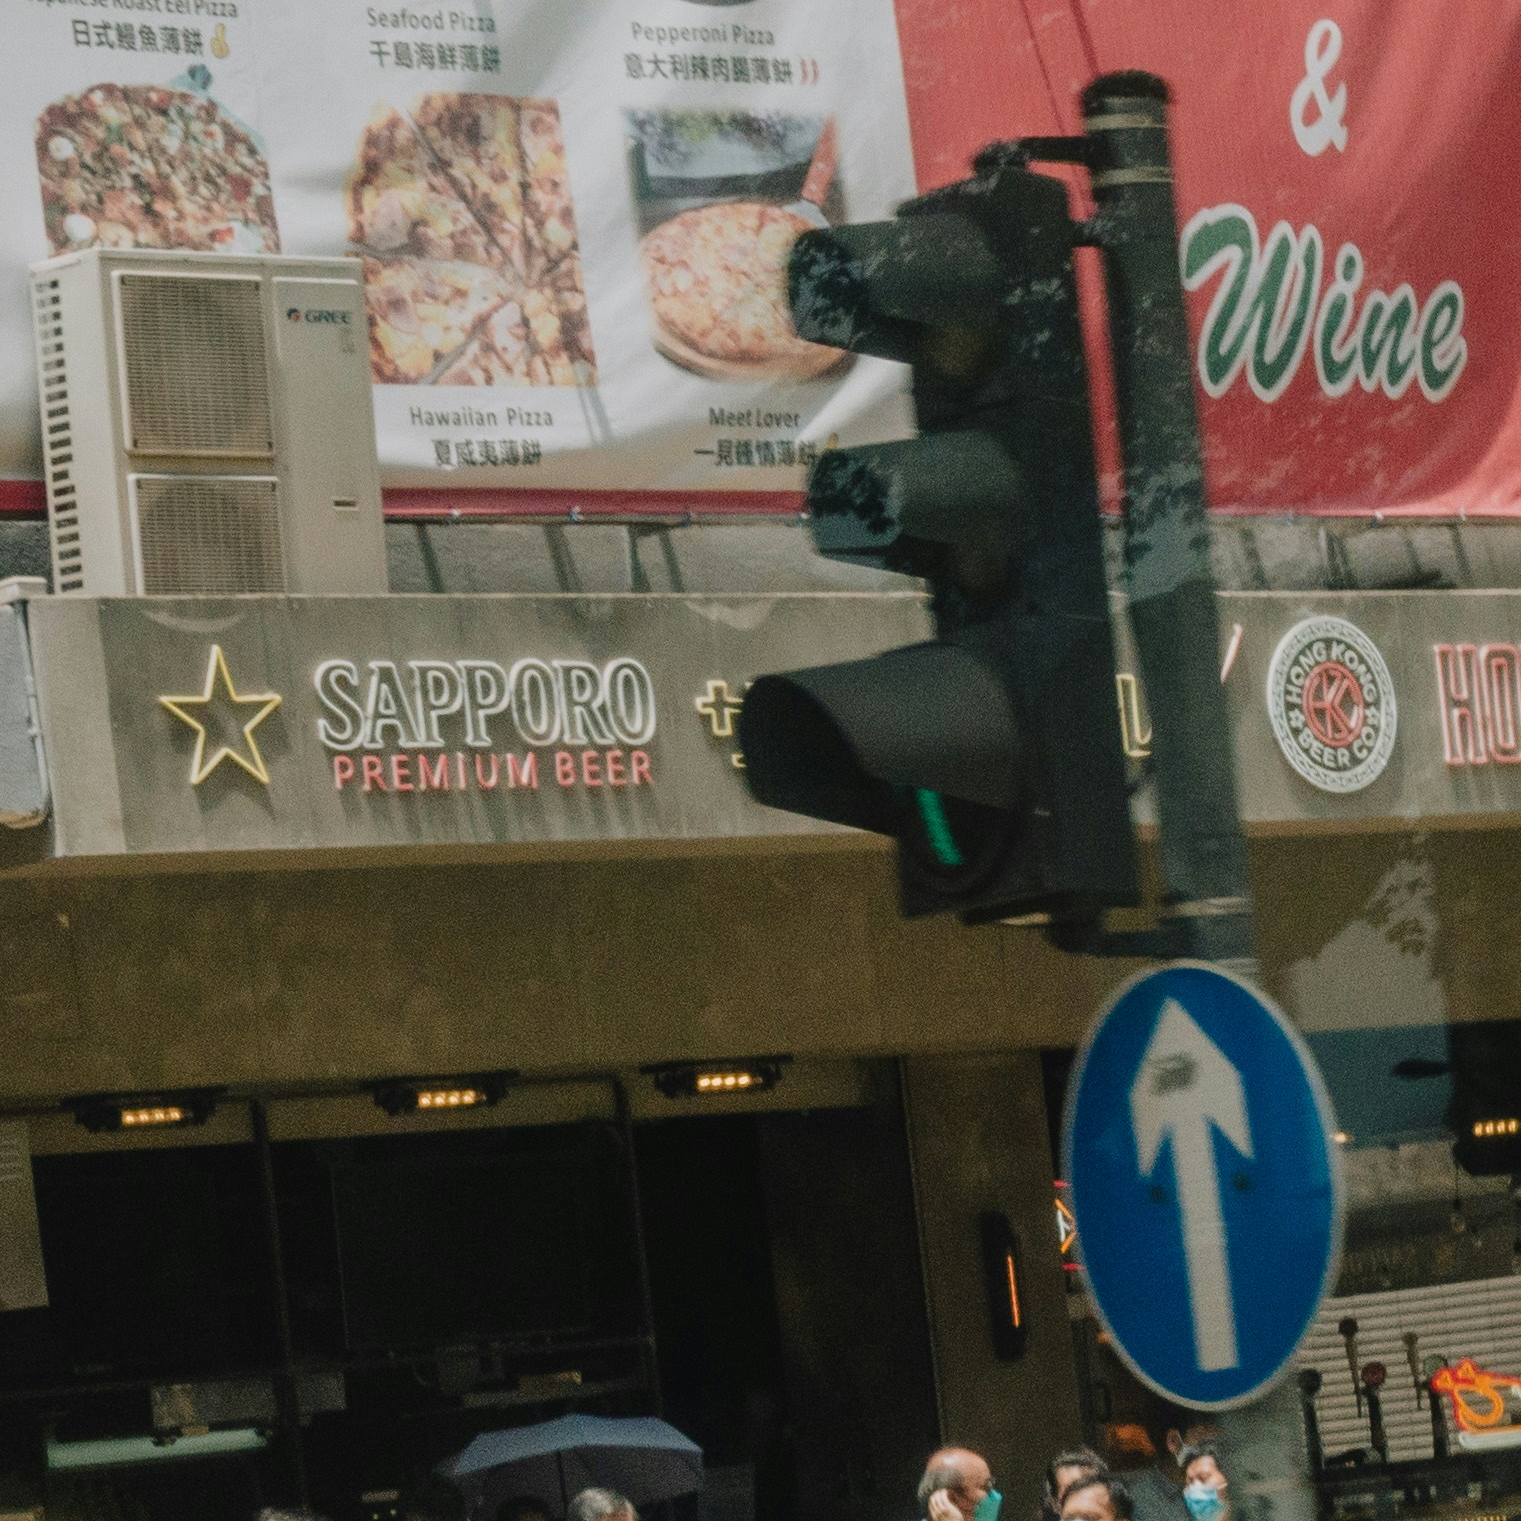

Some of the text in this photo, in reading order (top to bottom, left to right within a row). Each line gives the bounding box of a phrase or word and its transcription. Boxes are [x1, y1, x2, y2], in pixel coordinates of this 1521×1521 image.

[194, 0, 238, 18] Pizza
[367, 7, 496, 33] Seafood Pizza
[631, 22, 775, 45] Pepperoni Pizza
[1290, 19, 1348, 156] &
[1181, 203, 1467, 402] Wine
[410, 407, 553, 427] Hawaiian Pizza
[709, 407, 800, 427] Meet Lover
[1285, 641, 1377, 704] HONG KONG
[314, 657, 657, 750] SAPPORO
[1299, 726, 1375, 767] BEER CO
[333, 750, 655, 792] PREMIUM BEER
